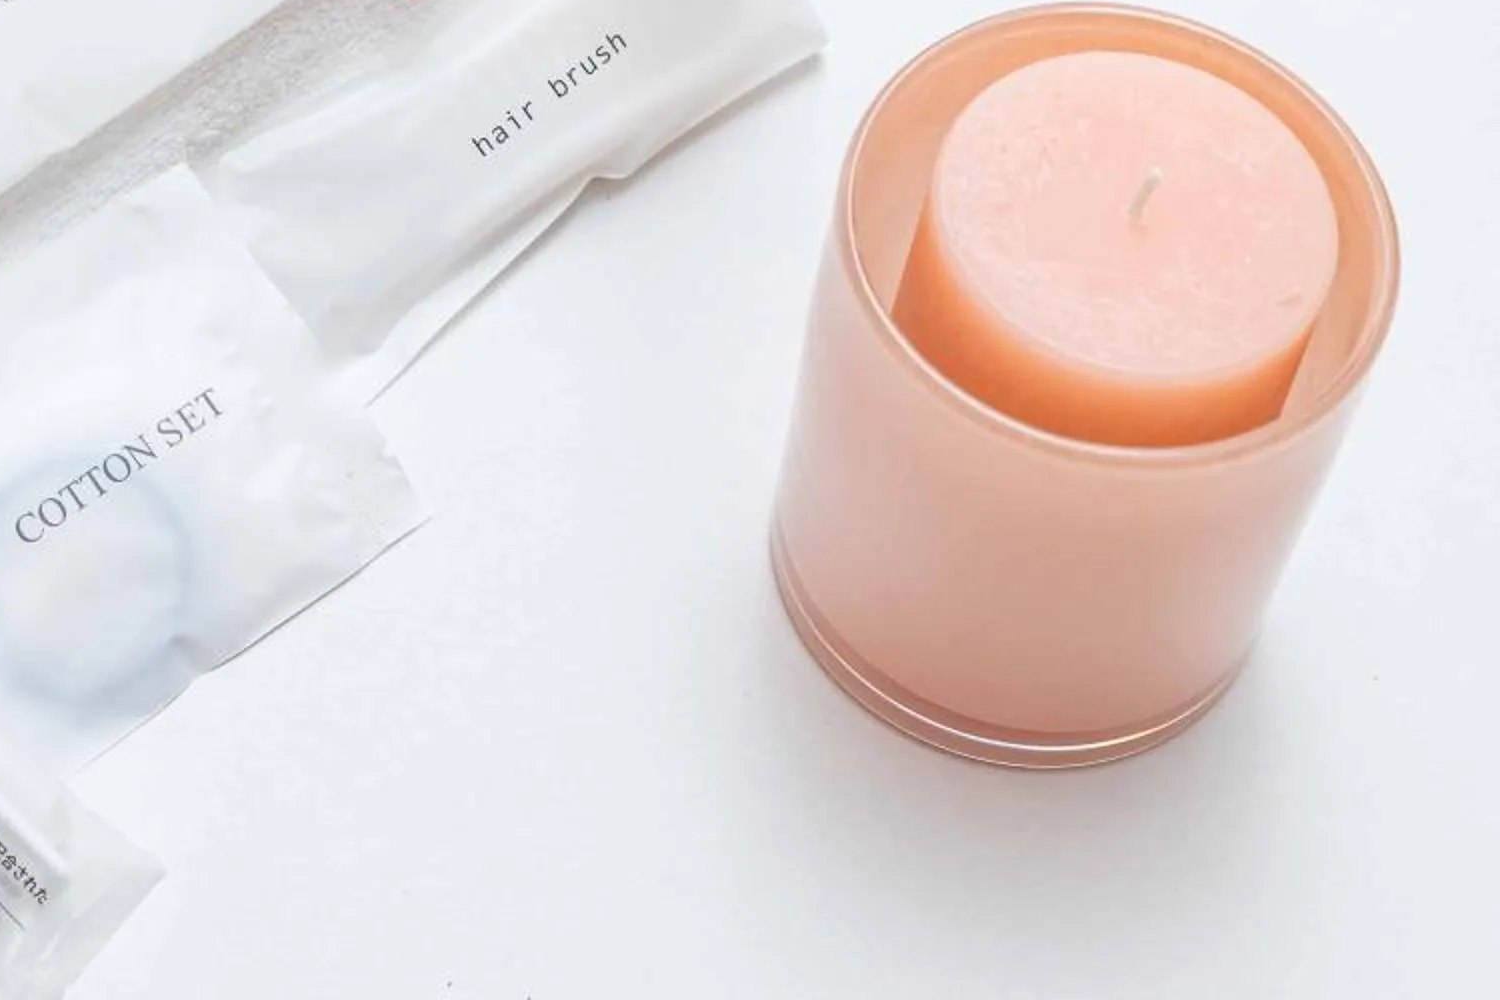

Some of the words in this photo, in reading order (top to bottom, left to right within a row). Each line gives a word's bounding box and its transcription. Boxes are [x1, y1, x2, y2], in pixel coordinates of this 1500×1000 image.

[471, 100, 534, 157] hair
[547, 33, 627, 99] brush
[15, 435, 158, 543] COTTON
[156, 388, 224, 449] SET
